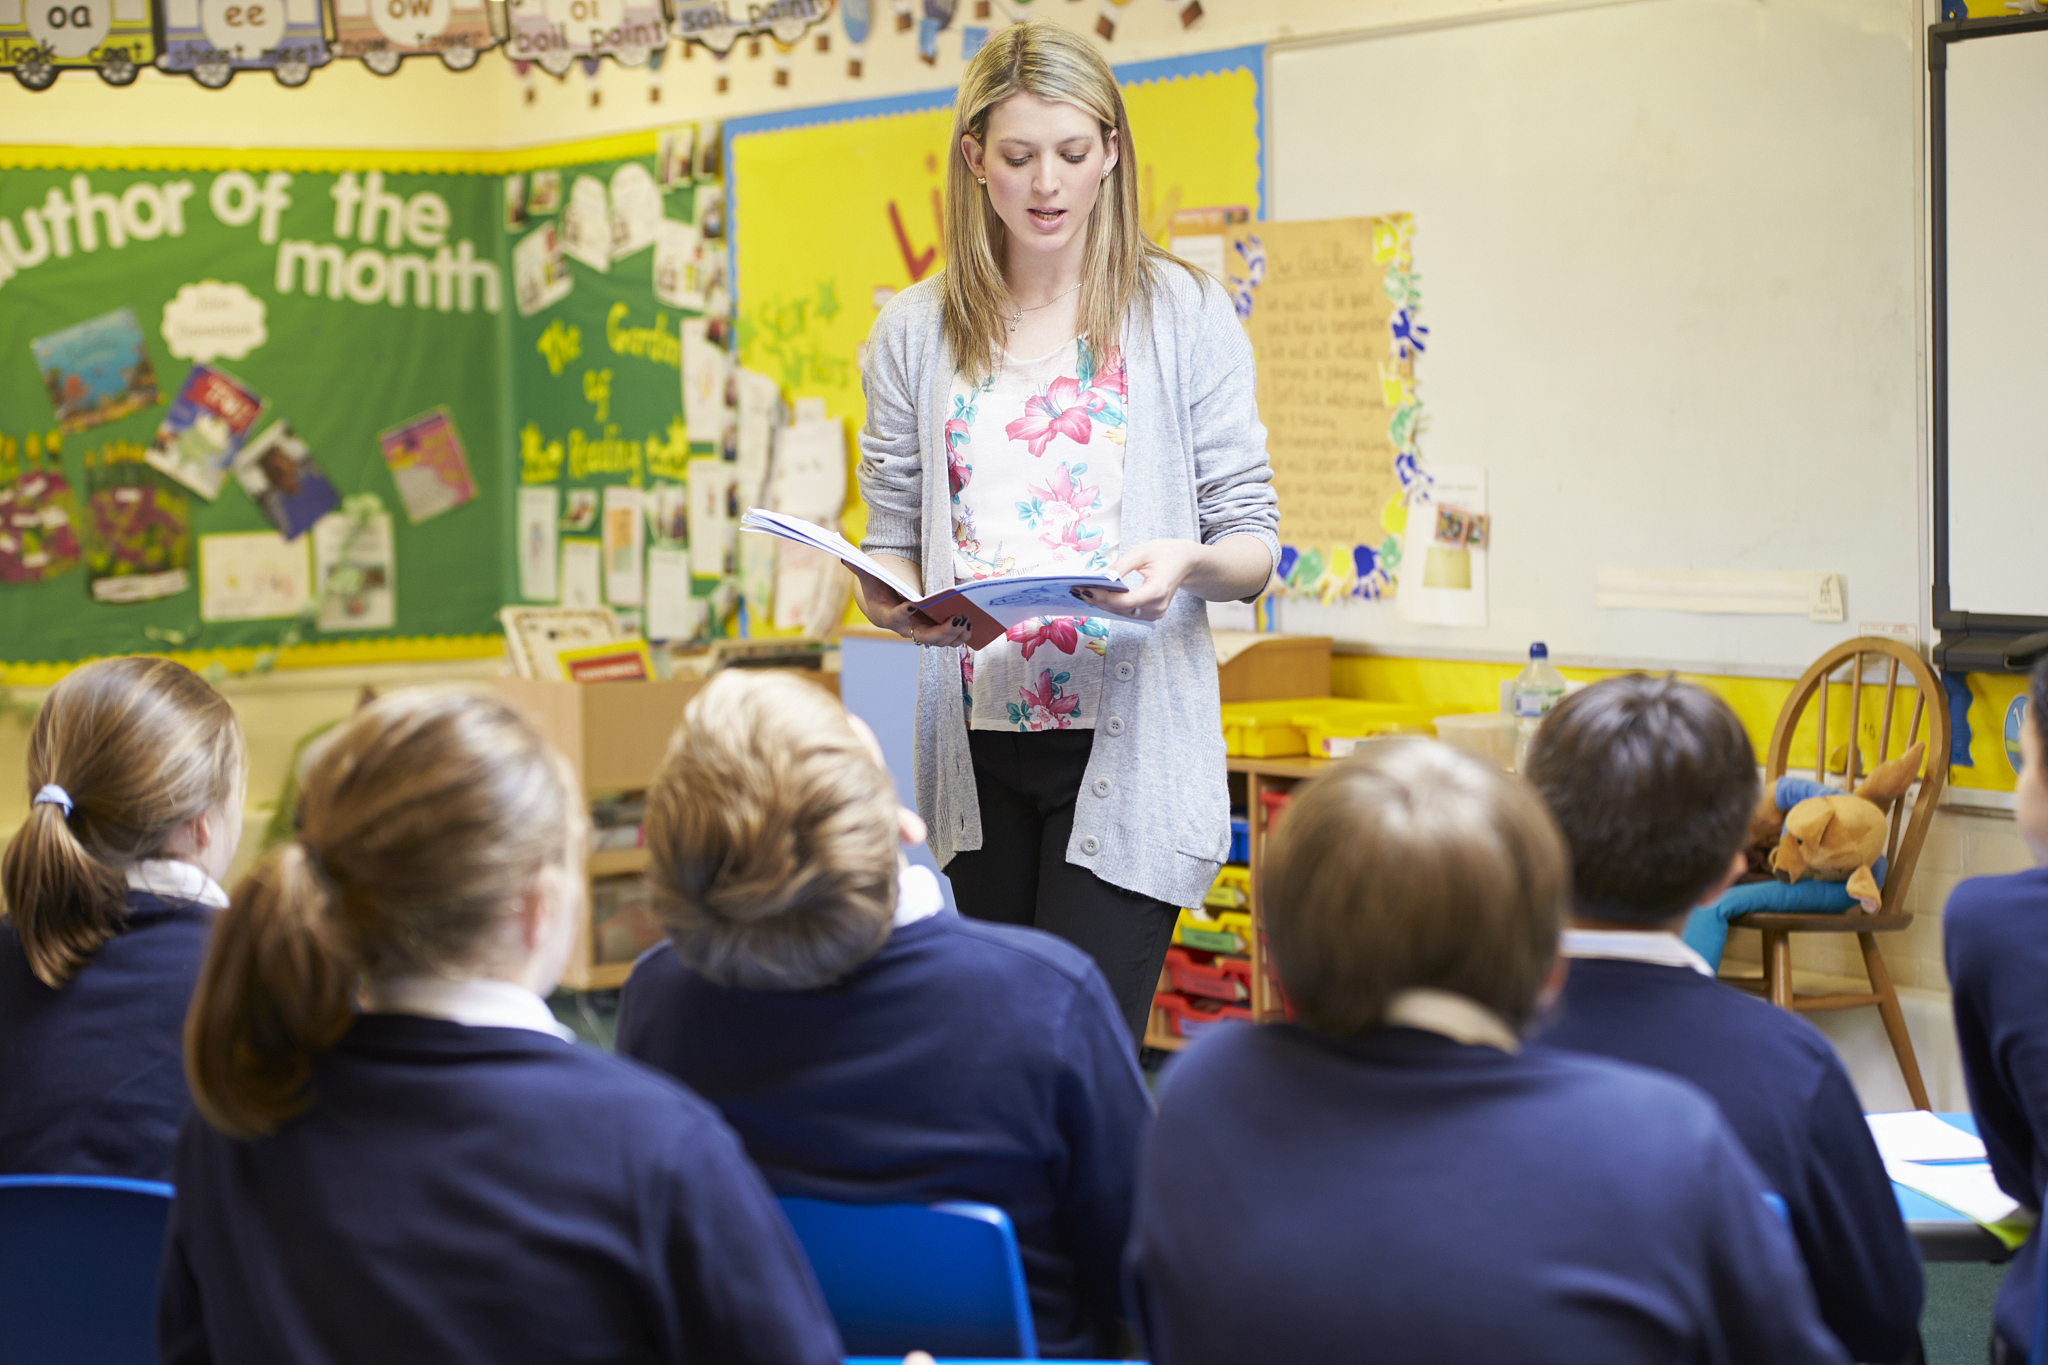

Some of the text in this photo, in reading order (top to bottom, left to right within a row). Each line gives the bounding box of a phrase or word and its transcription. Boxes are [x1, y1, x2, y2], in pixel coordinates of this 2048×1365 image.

[47, 5, 92, 28] oa
[224, 5, 265, 27] ee
[388, 0, 432, 18] ow
[590, 17, 663, 57] point
[0, 38, 143, 63] loak coat
[0, 168, 451, 288] uthor of the
[274, 237, 501, 314] month
